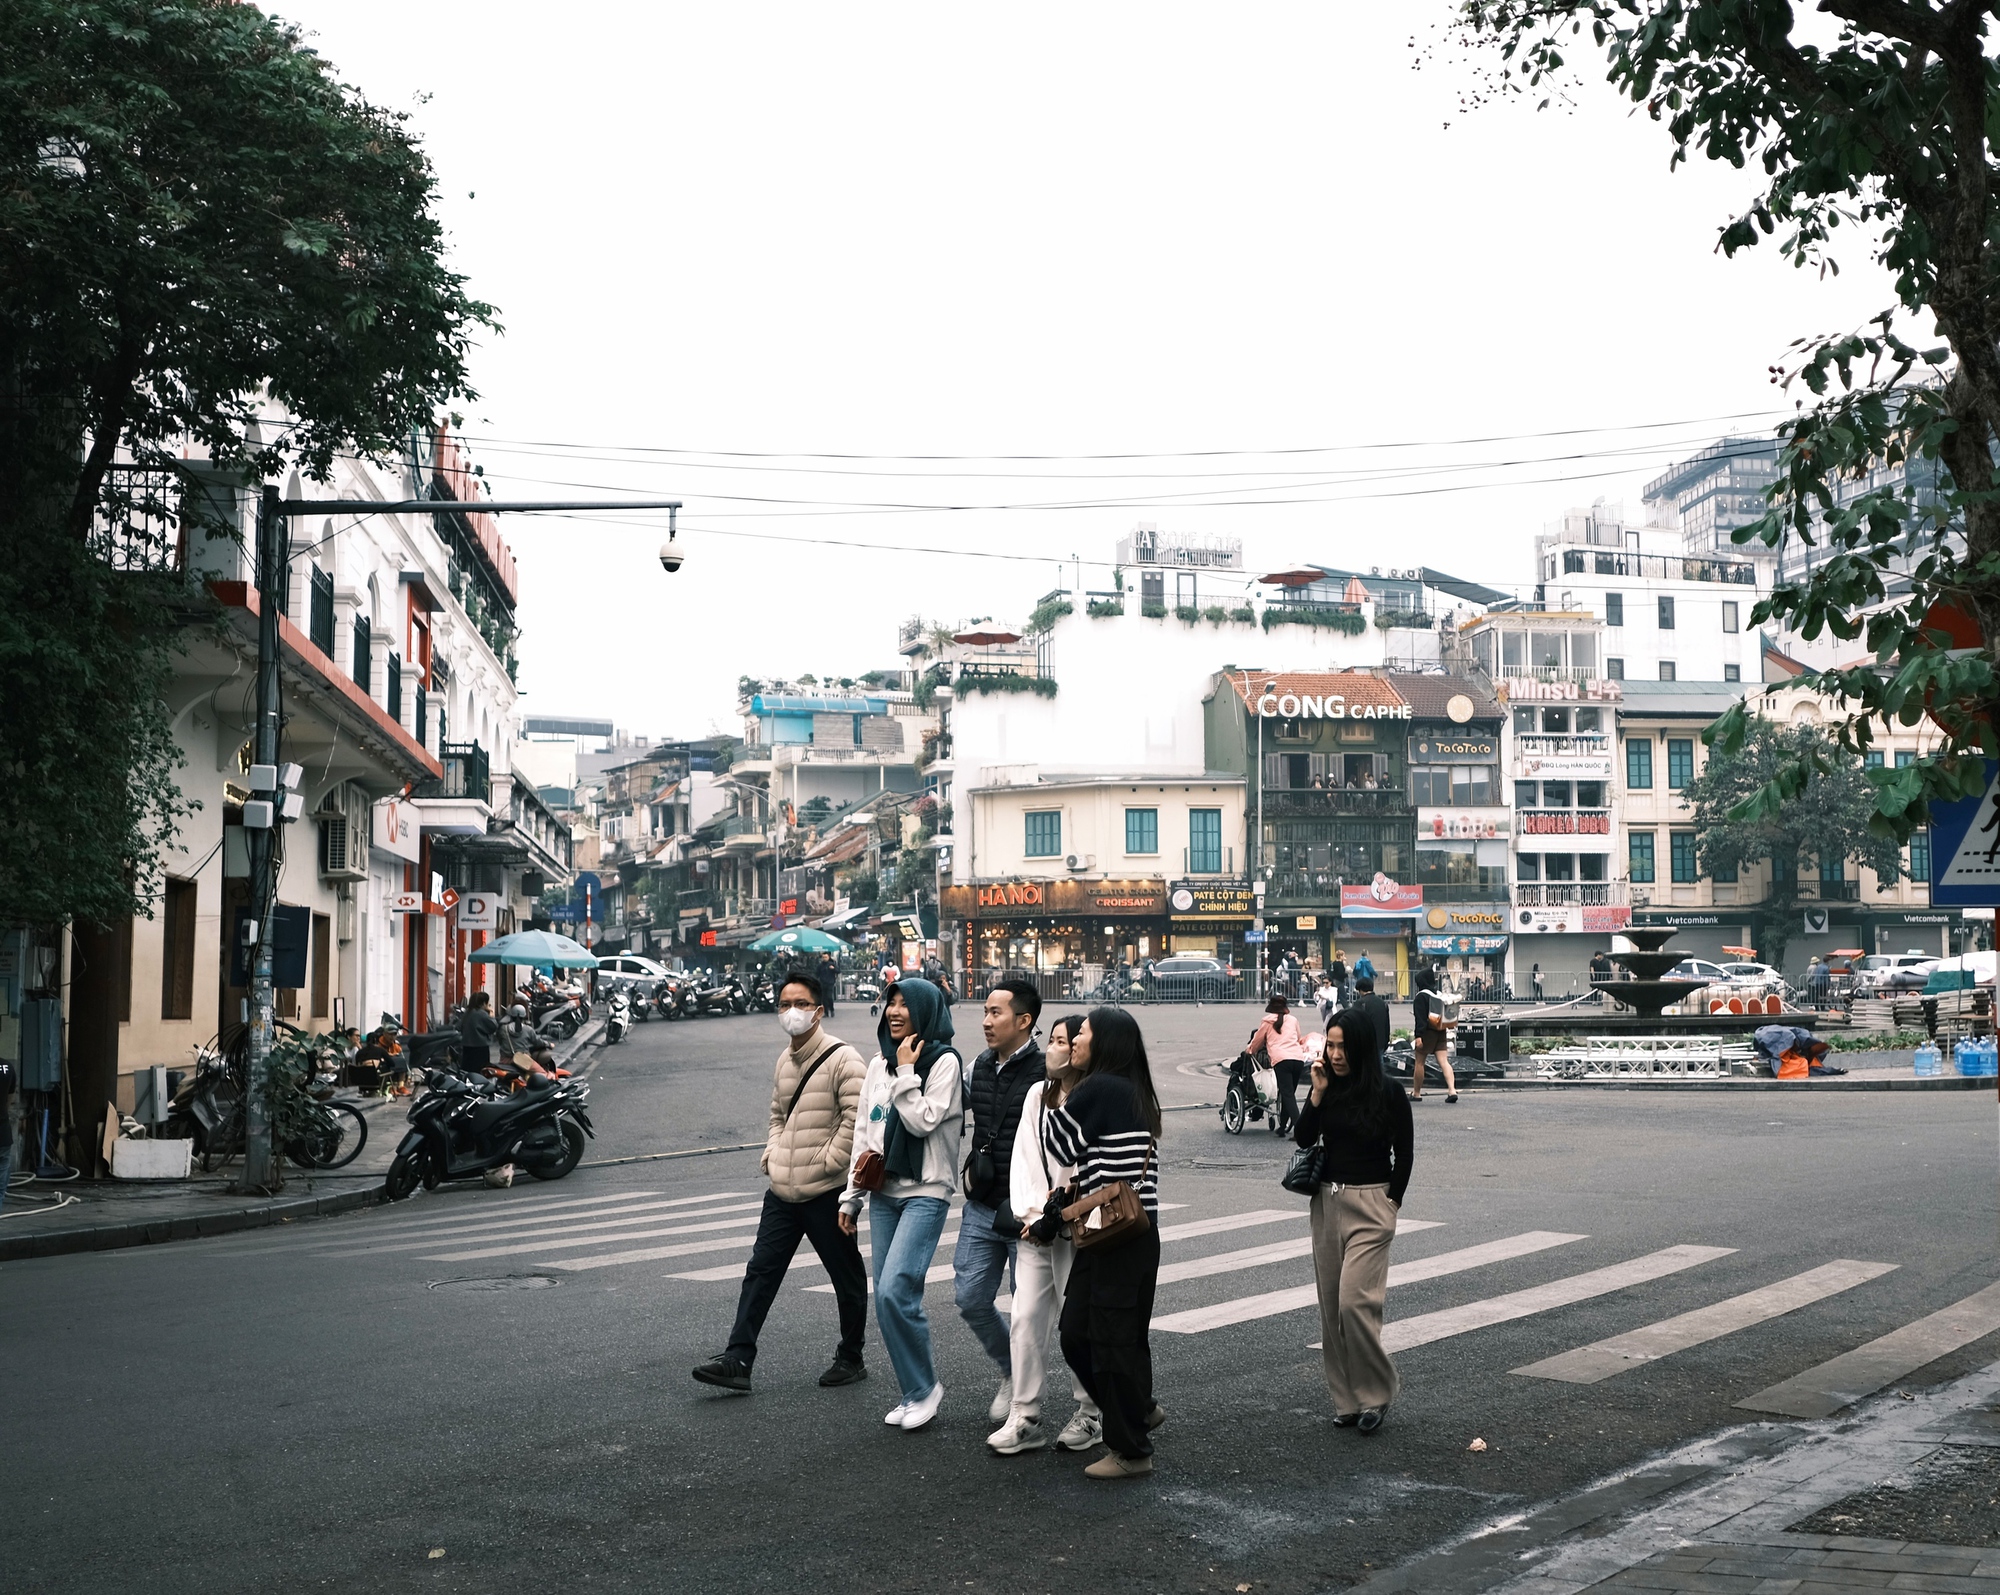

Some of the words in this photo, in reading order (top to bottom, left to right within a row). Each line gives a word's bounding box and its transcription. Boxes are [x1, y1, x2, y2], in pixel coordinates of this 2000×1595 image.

[1510, 677, 1579, 700] Minsu
[1526, 816, 1575, 834] KOREA
[1578, 816, 1610, 834] BBQ
[1096, 898, 1155, 907] CROISSANT
[1666, 915, 1719, 925] Vietcombank
[1903, 914, 1950, 923] Vietcombank
[1265, 925, 1279, 934] 116
